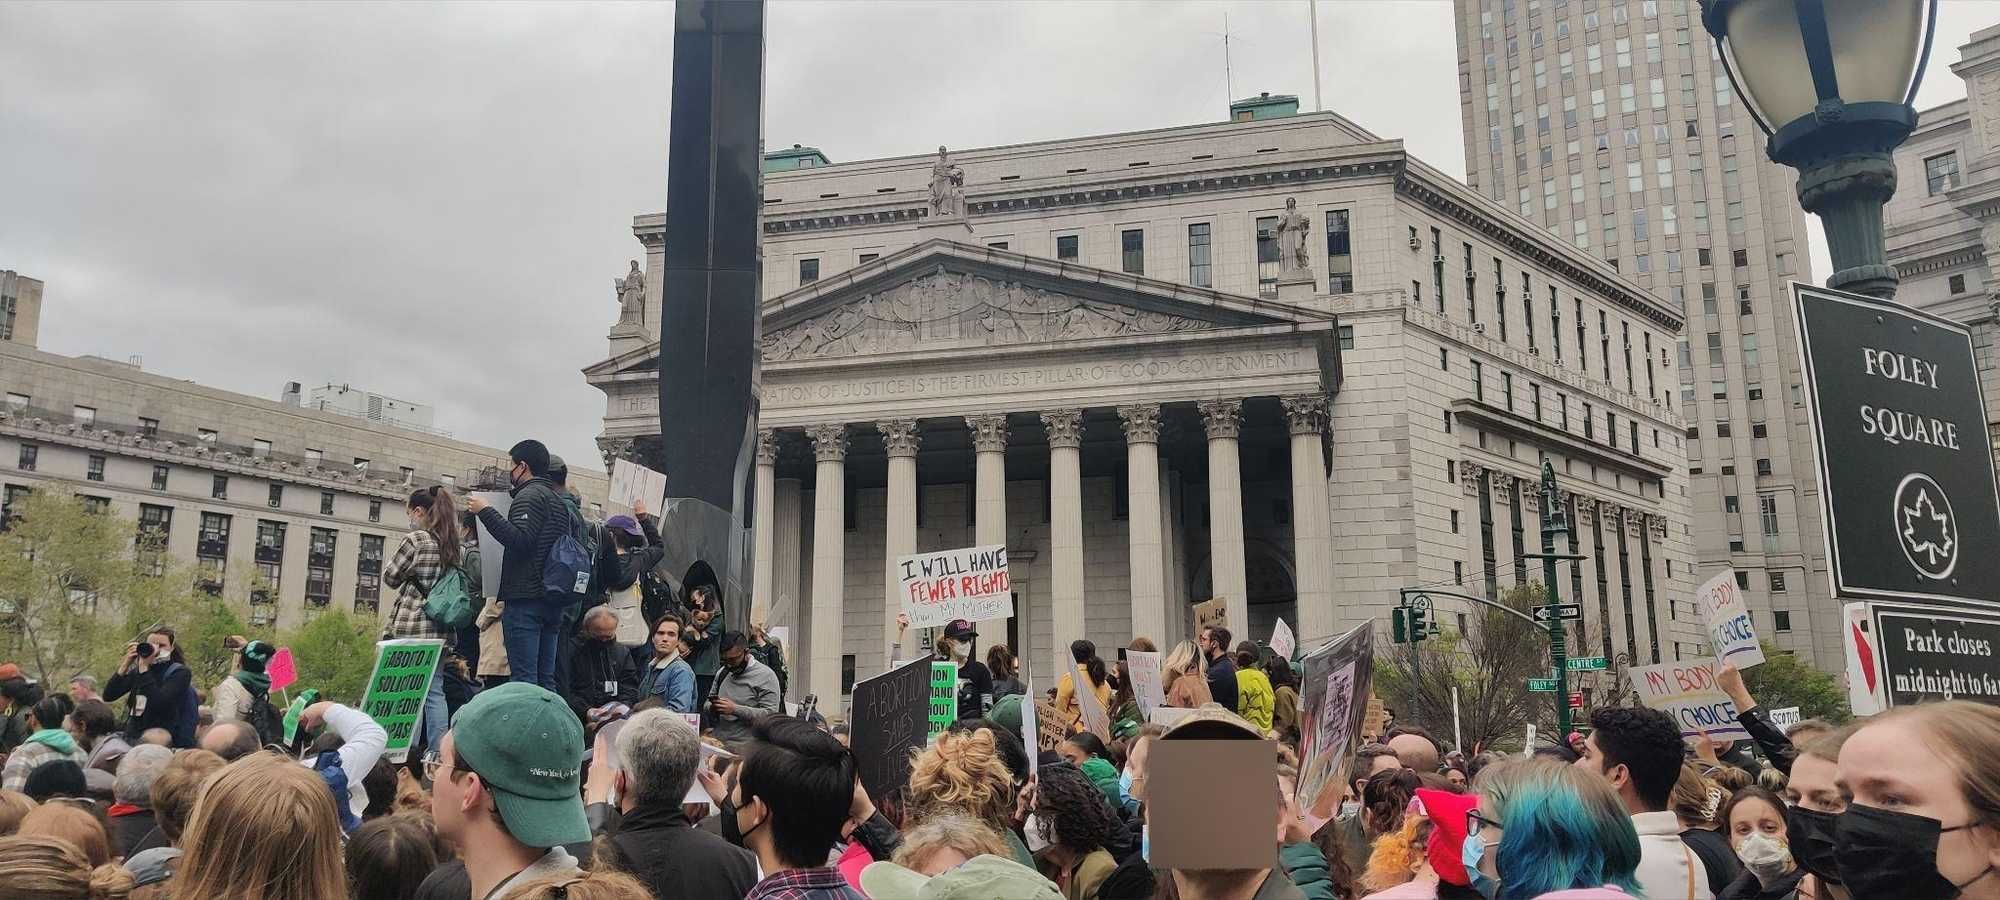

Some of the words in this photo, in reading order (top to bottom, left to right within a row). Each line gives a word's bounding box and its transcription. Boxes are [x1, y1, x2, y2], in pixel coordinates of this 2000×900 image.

[761, 384, 813, 401] RATION
[818, 384, 839, 398] OF
[845, 379, 904, 396] JUSTICE
[911, 378, 925, 393] IS
[930, 377, 958, 392] THE
[964, 371, 1028, 390] FIRMEST
[1035, 367, 1085, 384] PILLAR
[1090, 366, 1113, 380] OF
[1119, 361, 1171, 378] GOOD
[1179, 352, 1299, 374] GOVERNMENT
[1862, 347, 1939, 389] FOLEY
[1860, 404, 1960, 450] SQUARE
[901, 560, 917, 581] I
[921, 556, 968, 577] WILL
[970, 547, 1007, 572] HAVE
[909, 577, 956, 603] FEWER
[962, 570, 1009, 597] RIGHTS
[1712, 579, 1734, 610] BODY
[1719, 615, 1753, 645] CHOICE
[1904, 627, 1945, 653] Park
[1947, 630, 1992, 657] closes
[1567, 658, 1594, 669] CENTRE
[1645, 669, 1671, 695] MY
[1673, 661, 1720, 692] BODY
[866, 665, 928, 721] ABORTION
[1530, 680, 1548, 690] FOLEY
[1895, 667, 1966, 701] midnight
[1968, 672, 1981, 695] to
[373, 700, 394, 718] SIN
[394, 697, 421, 715] EDIR
[1681, 701, 1740, 729] CHOICE
[1772, 711, 1799, 725] SCOTUS
